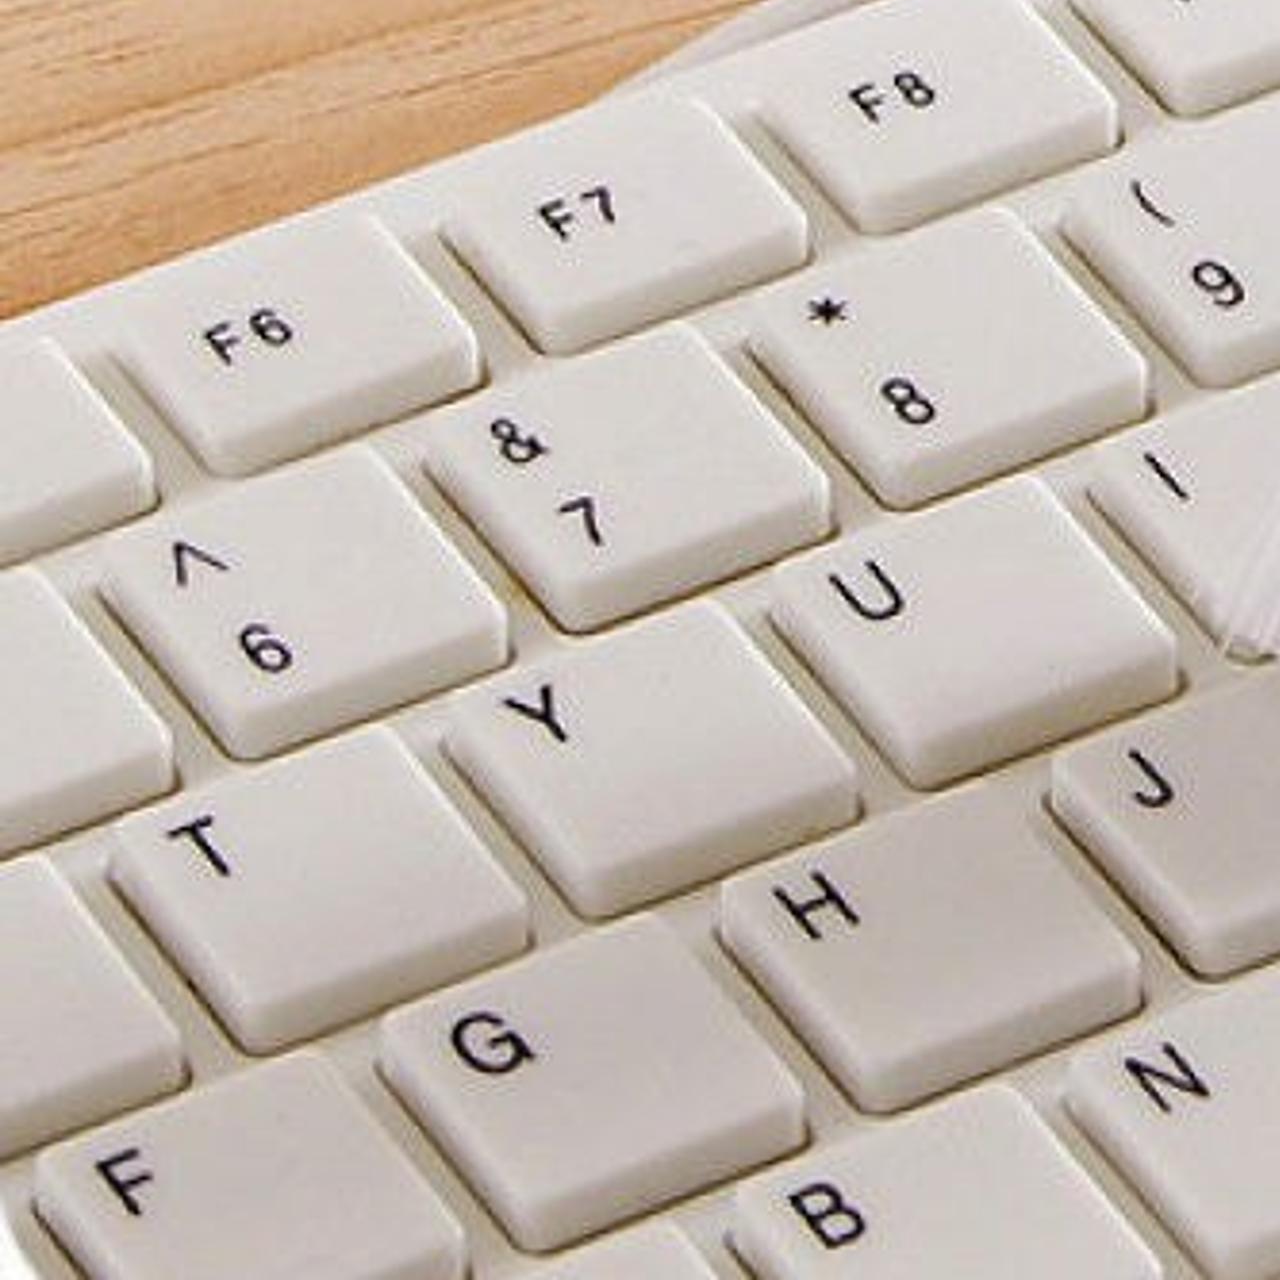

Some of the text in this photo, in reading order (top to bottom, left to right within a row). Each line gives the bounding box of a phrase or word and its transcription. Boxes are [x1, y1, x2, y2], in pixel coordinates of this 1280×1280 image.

[847, 71, 936, 124] F8
[537, 186, 616, 242] F7
[1190, 260, 1245, 310] 9
[202, 308, 293, 366] F6
[880, 377, 937, 426] 8
[557, 496, 603, 547] 7
[828, 560, 905, 622] U
[237, 623, 293, 674] 6
[502, 684, 569, 744] Y
[1127, 749, 1175, 809] J
[166, 815, 231, 878] T
[772, 871, 861, 941] H
[449, 1011, 537, 1076] G
[1124, 1042, 1211, 1113] N
[94, 1148, 154, 1217] F
[786, 1182, 867, 1250] B
